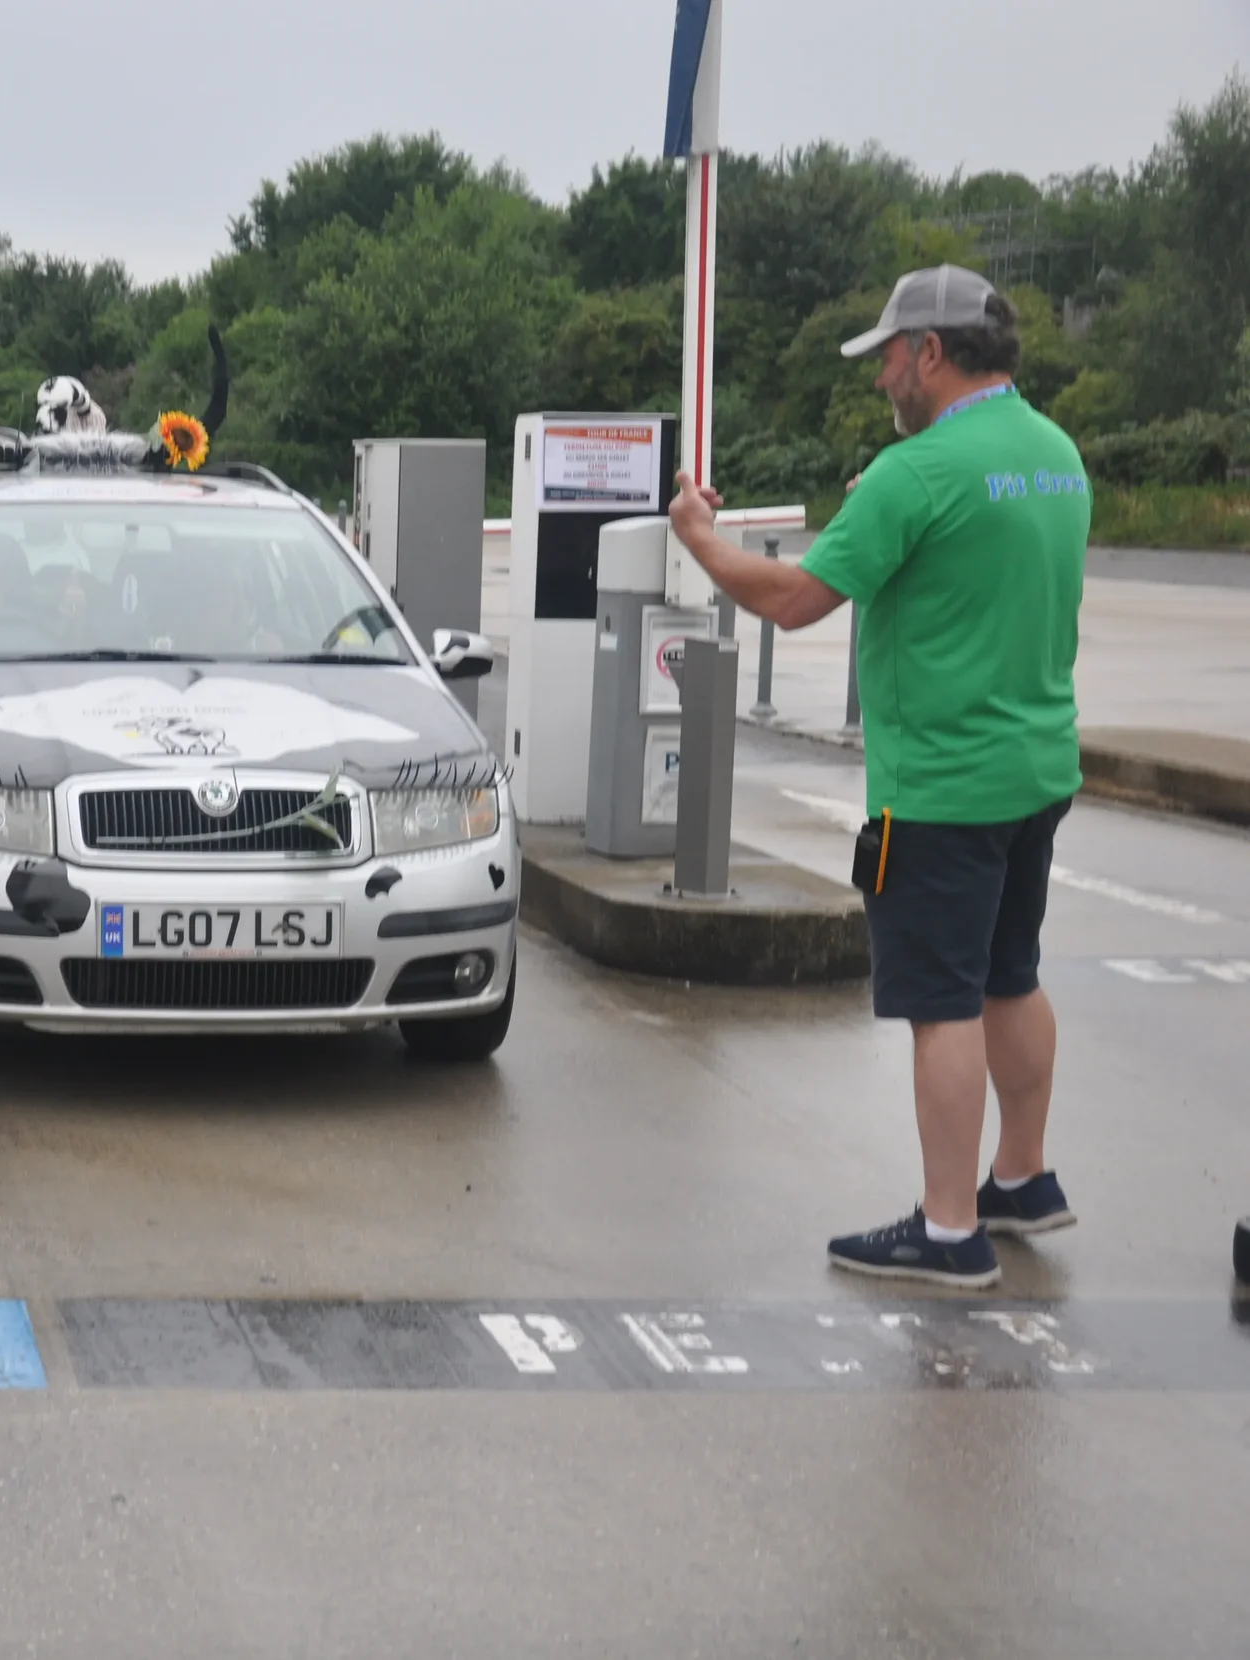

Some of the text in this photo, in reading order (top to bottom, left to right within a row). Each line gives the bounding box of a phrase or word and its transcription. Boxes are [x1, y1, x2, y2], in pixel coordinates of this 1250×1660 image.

[984, 472, 1027, 501] Pit
[106, 931, 121, 944] UK
[132, 909, 333, 948] LG07 LSJ
